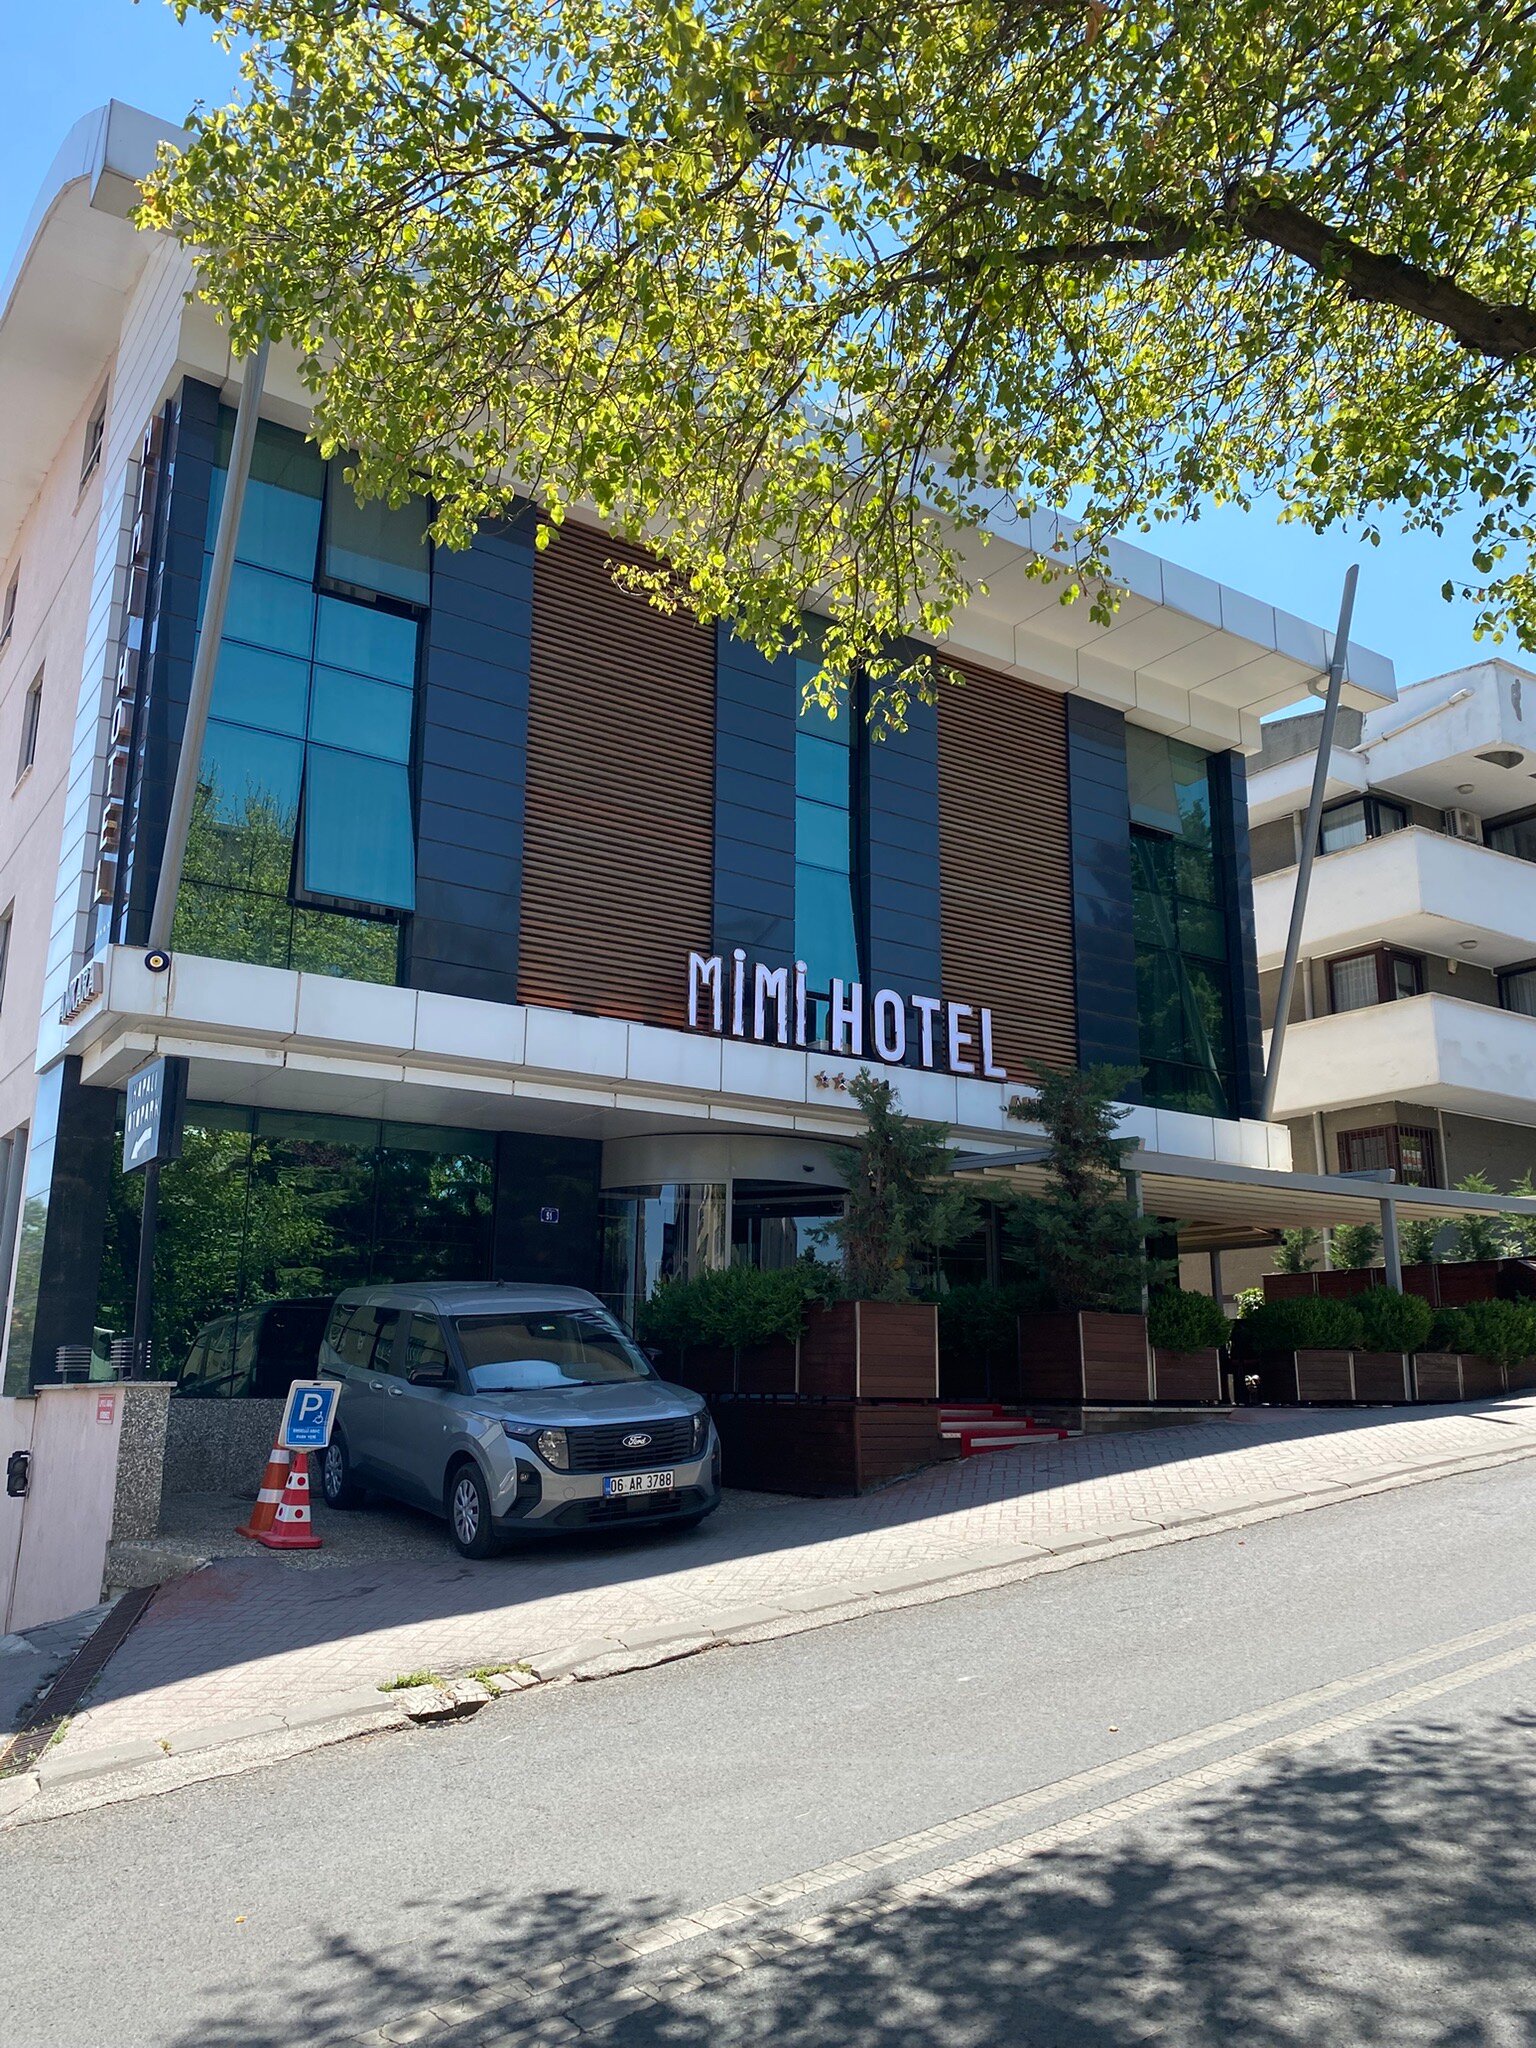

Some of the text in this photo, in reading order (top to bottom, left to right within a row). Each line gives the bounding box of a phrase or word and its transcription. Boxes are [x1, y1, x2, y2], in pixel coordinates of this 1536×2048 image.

[94, 648, 132, 903] HOTEL
[832, 977, 1007, 1078] HOTEL
[132, 1070, 159, 1104] KAPALI
[127, 1097, 161, 1133] OTOPARK
[298, 1393, 323, 1421] P
[627, 1435, 646, 1446] Ford
[610, 1478, 624, 1493] 06
[629, 1476, 643, 1491] AR
[646, 1472, 672, 1489] 3788
